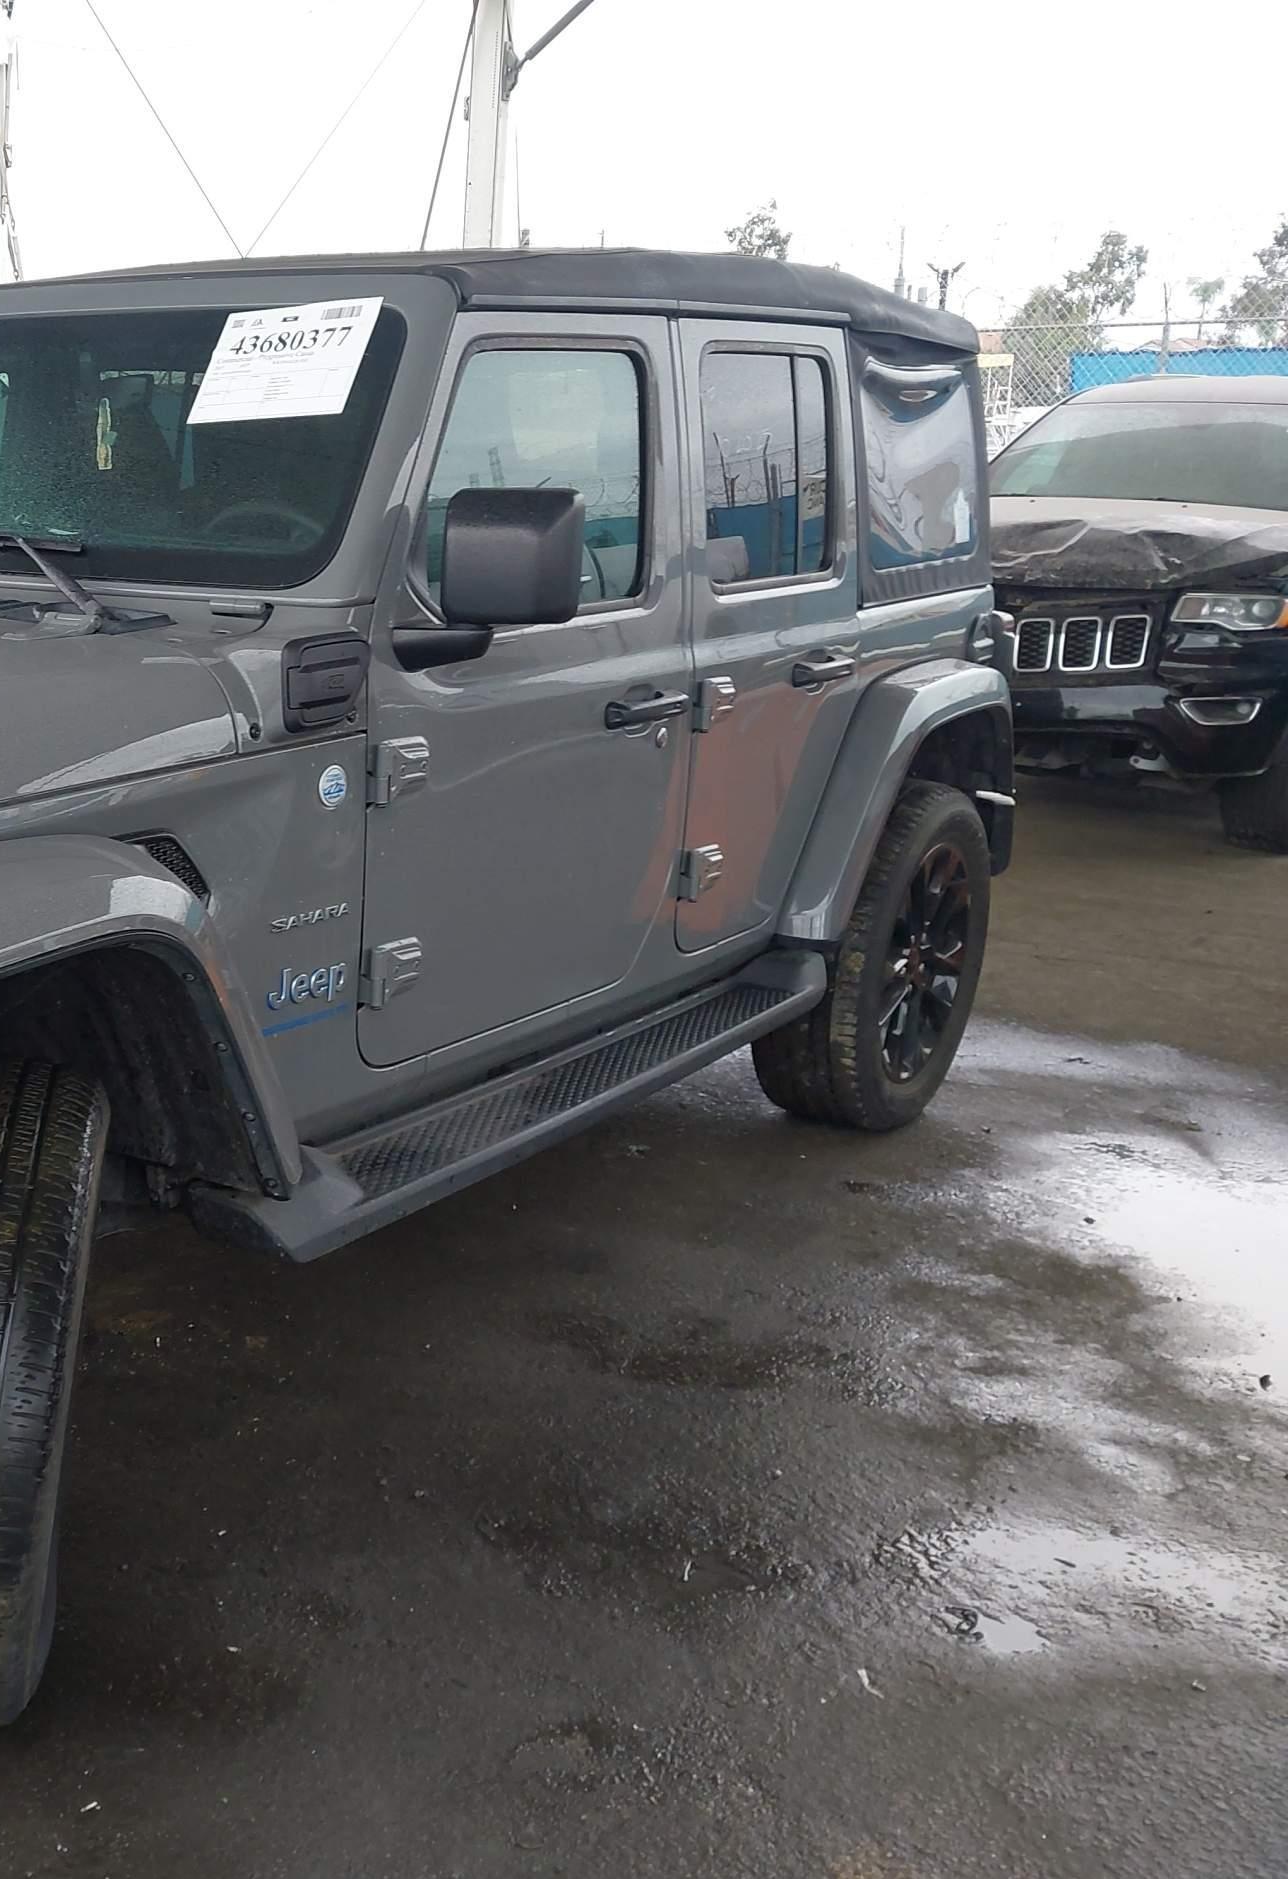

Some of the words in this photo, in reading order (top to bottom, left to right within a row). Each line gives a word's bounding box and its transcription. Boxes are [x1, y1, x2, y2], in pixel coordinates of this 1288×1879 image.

[230, 326, 353, 355] 43680377
[270, 903, 350, 933] SAHARA
[267, 962, 346, 1011] Jeep
